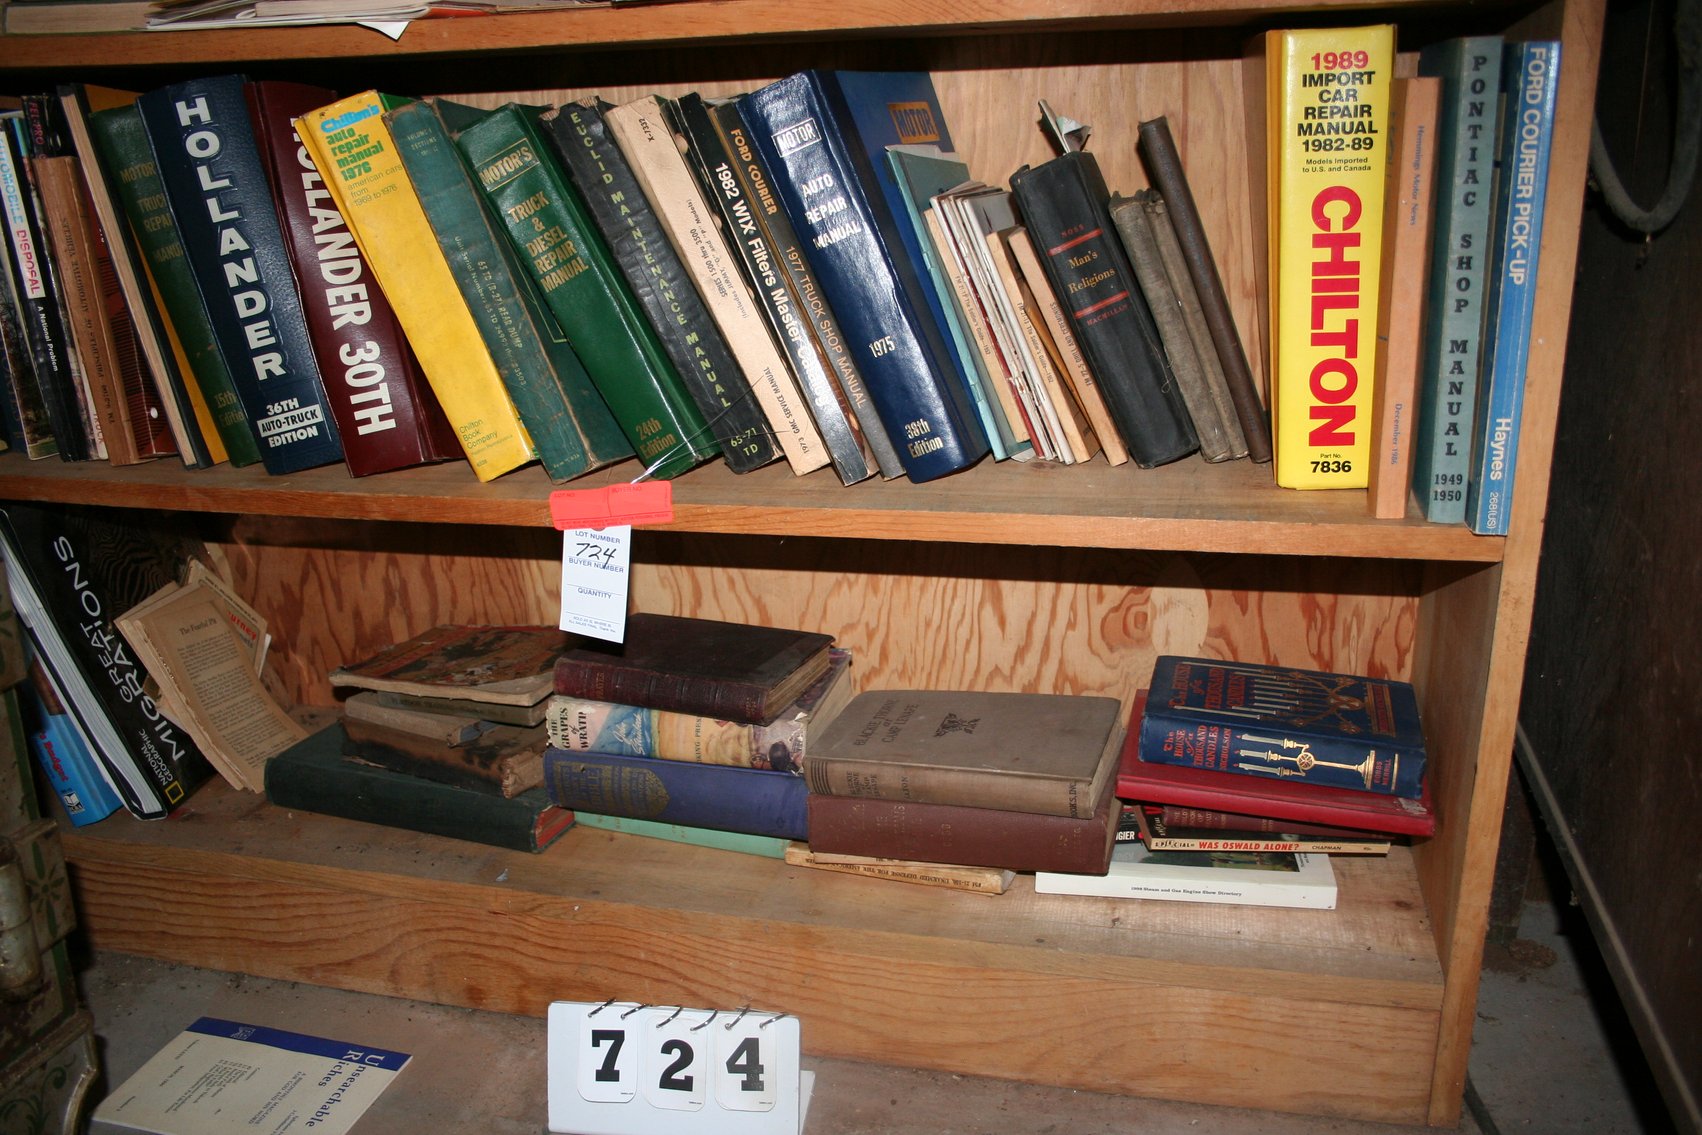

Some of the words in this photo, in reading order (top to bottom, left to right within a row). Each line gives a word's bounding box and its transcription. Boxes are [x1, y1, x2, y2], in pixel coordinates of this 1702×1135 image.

[1311, 50, 1369, 71] 1989
[1302, 71, 1376, 87] IMPORT
[1525, 47, 1547, 105] FORD
[1318, 88, 1358, 103] CAR
[29, 102, 45, 145] FEL-PRO
[320, 104, 380, 134] Chilton's
[892, 108, 938, 138] MOTOR
[1304, 104, 1372, 120] REPAIR
[325, 127, 356, 146] auto
[638, 118, 655, 143] X-7332
[776, 123, 816, 152] MOTOR
[1297, 121, 1378, 137] MANUAL
[1463, 56, 1488, 207] PONTIAC
[331, 132, 370, 158] repair
[336, 140, 384, 169] manual
[1302, 136, 1374, 152] 1982-89
[1413, 125, 1425, 171] Hemmings
[1516, 110, 1542, 199] COURIER
[341, 161, 372, 182] 1976
[479, 146, 533, 185] MOTOR'S
[730, 128, 753, 162] FORD
[748, 162, 777, 216] COURIER
[1334, 157, 1368, 166] Imported
[348, 171, 384, 191] american
[385, 164, 403, 177] cars
[802, 173, 835, 198] AUTO
[1411, 174, 1422, 200] Motor
[350, 186, 369, 199] from
[373, 190, 382, 199] to
[508, 191, 549, 223] TRUCK
[804, 197, 849, 226] REPAIR
[1409, 202, 1420, 225] News
[60, 217, 76, 258] VEHICLES
[534, 217, 545, 232] &
[689, 226, 704, 245] 3500
[813, 221, 862, 250] MANUAL
[175, 96, 287, 381] HOLLANDER
[526, 226, 567, 257] DIESEL
[698, 243, 711, 259] thru
[1508, 203, 1531, 286] PICK-UP
[16, 229, 41, 295] DISPOSAL
[460, 249, 475, 273] Serial
[534, 241, 577, 274] REPAIR
[570, 112, 614, 184] EUCLID
[610, 190, 688, 326] MAINTENANCE
[685, 331, 731, 408] MANUAL
[705, 257, 719, 276] 1500
[1068, 250, 1099, 269] Man's
[70, 259, 90, 313] AUTOMOTIVE
[541, 257, 589, 293] MANUAL
[714, 275, 730, 297] SERIES
[715, 162, 740, 200] 1982
[732, 200, 756, 236] WIX
[748, 238, 778, 287] Filters
[770, 286, 801, 342] Master
[797, 345, 829, 407] Catalog
[1068, 267, 1116, 295] Religions
[1454, 234, 1473, 313] SHOP
[477, 260, 489, 271] 65
[498, 304, 514, 328] REAR
[507, 326, 524, 349] DUMP
[963, 297, 972, 308] The
[785, 245, 804, 274] 1977
[799, 275, 828, 319] TRUCK
[819, 318, 844, 354] SHOP
[836, 354, 868, 409] MANUAL
[966, 306, 980, 328] Soldier's
[1048, 300, 1070, 335] CEREMONIES
[1308, 185, 1363, 447] CHILTON
[40, 313, 51, 343] National
[49, 343, 59, 372] Problem
[1025, 324, 1034, 335] The
[1063, 333, 1075, 348] AND
[868, 335, 896, 359] 1975
[1029, 334, 1042, 355] Soldier's
[1069, 346, 1083, 364] DRILL
[338, 341, 397, 436] 30TH
[761, 365, 781, 394] MANUAL
[266, 398, 300, 416] 36TH
[775, 393, 793, 419] SERVICE
[1444, 339, 1469, 457] MANUAL
[261, 408, 319, 433] AUTO-TRUCK
[459, 418, 484, 435] Chilton
[636, 418, 662, 441] 24th
[787, 417, 801, 435] GMC
[904, 418, 931, 439] 38th
[1392, 403, 1403, 447] December
[268, 426, 319, 448] EDITION
[462, 428, 483, 443] Book
[466, 430, 498, 450] Company
[642, 432, 677, 459] Edition
[730, 428, 757, 448] 65-71
[907, 436, 944, 459] Edition
[743, 444, 759, 456] TD
[1490, 418, 1511, 481] Haynes
[1310, 460, 1352, 473] 7836
[1434, 473, 1463, 485] 1949
[1433, 490, 1462, 502] 1950
[574, 530, 589, 539] LOT
[590, 533, 620, 545] NUMBER
[568, 557, 593, 568] BUYER
[593, 562, 624, 573] NUMBER
[576, 542, 616, 569] 724
[577, 587, 613, 599] QUANTITY
[53, 535, 186, 762] MIGRATIONS
[80, 622, 133, 703] GREAT
[1175, 663, 1191, 691] HOUSE
[1204, 667, 1226, 709] THOUSAND
[1229, 672, 1246, 709] CANDLES
[551, 718, 560, 737] THE
[560, 707, 569, 749] GRAPES
[570, 724, 580, 736] of
[854, 720, 881, 747] BLACKIE
[882, 721, 901, 744] CAMP
[1163, 731, 1174, 752] The
[1174, 728, 1187, 758] HOUSE
[1192, 724, 1207, 767] THOUSAND
[1205, 726, 1219, 769] CANDLES
[1219, 727, 1232, 771] NICHOLSON
[138, 728, 174, 782] GEOGRAPHIC
[140, 743, 169, 786] NATIONAL
[1373, 758, 1383, 783] BOBBS
[1381, 758, 1391, 787] MERRILL
[1198, 841, 1220, 850] WAS
[1220, 841, 1262, 850] OSWALD
[1263, 841, 1299, 851] ALONE?
[876, 867, 889, 875] FOR
[890, 869, 917, 879] DEFENSE
[918, 873, 949, 884] UNARMED
[1217, 890, 1242, 898] Directory
[317, 1049, 361, 1088] Riches
[304, 1055, 386, 1128] Unsearchable
